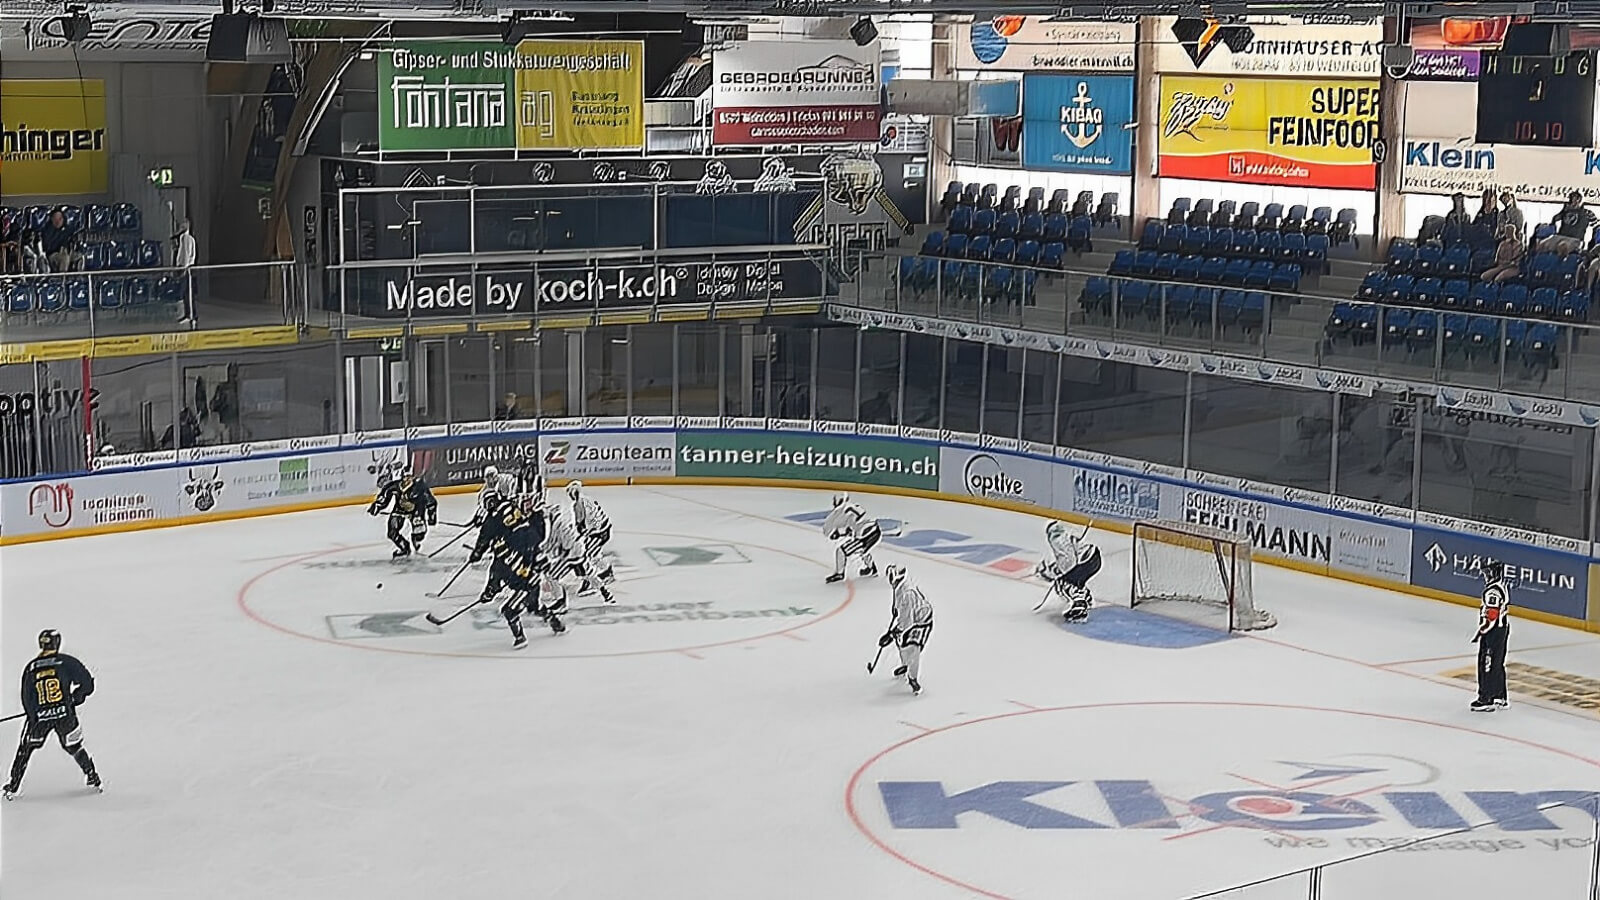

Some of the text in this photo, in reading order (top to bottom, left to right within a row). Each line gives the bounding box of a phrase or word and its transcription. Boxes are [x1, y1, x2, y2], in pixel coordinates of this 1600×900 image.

[452, 51, 478, 68] und
[1406, 141, 1495, 169] Klein
[387, 277, 471, 310] Made
[486, 276, 523, 310] by
[446, 443, 536, 465] ULMANN AG
[575, 444, 672, 461] Zaunteam
[681, 445, 937, 476] tanner-heizungen.ch
[970, 471, 1023, 496] optive
[1453, 553, 1575, 590] HÄERLIN
